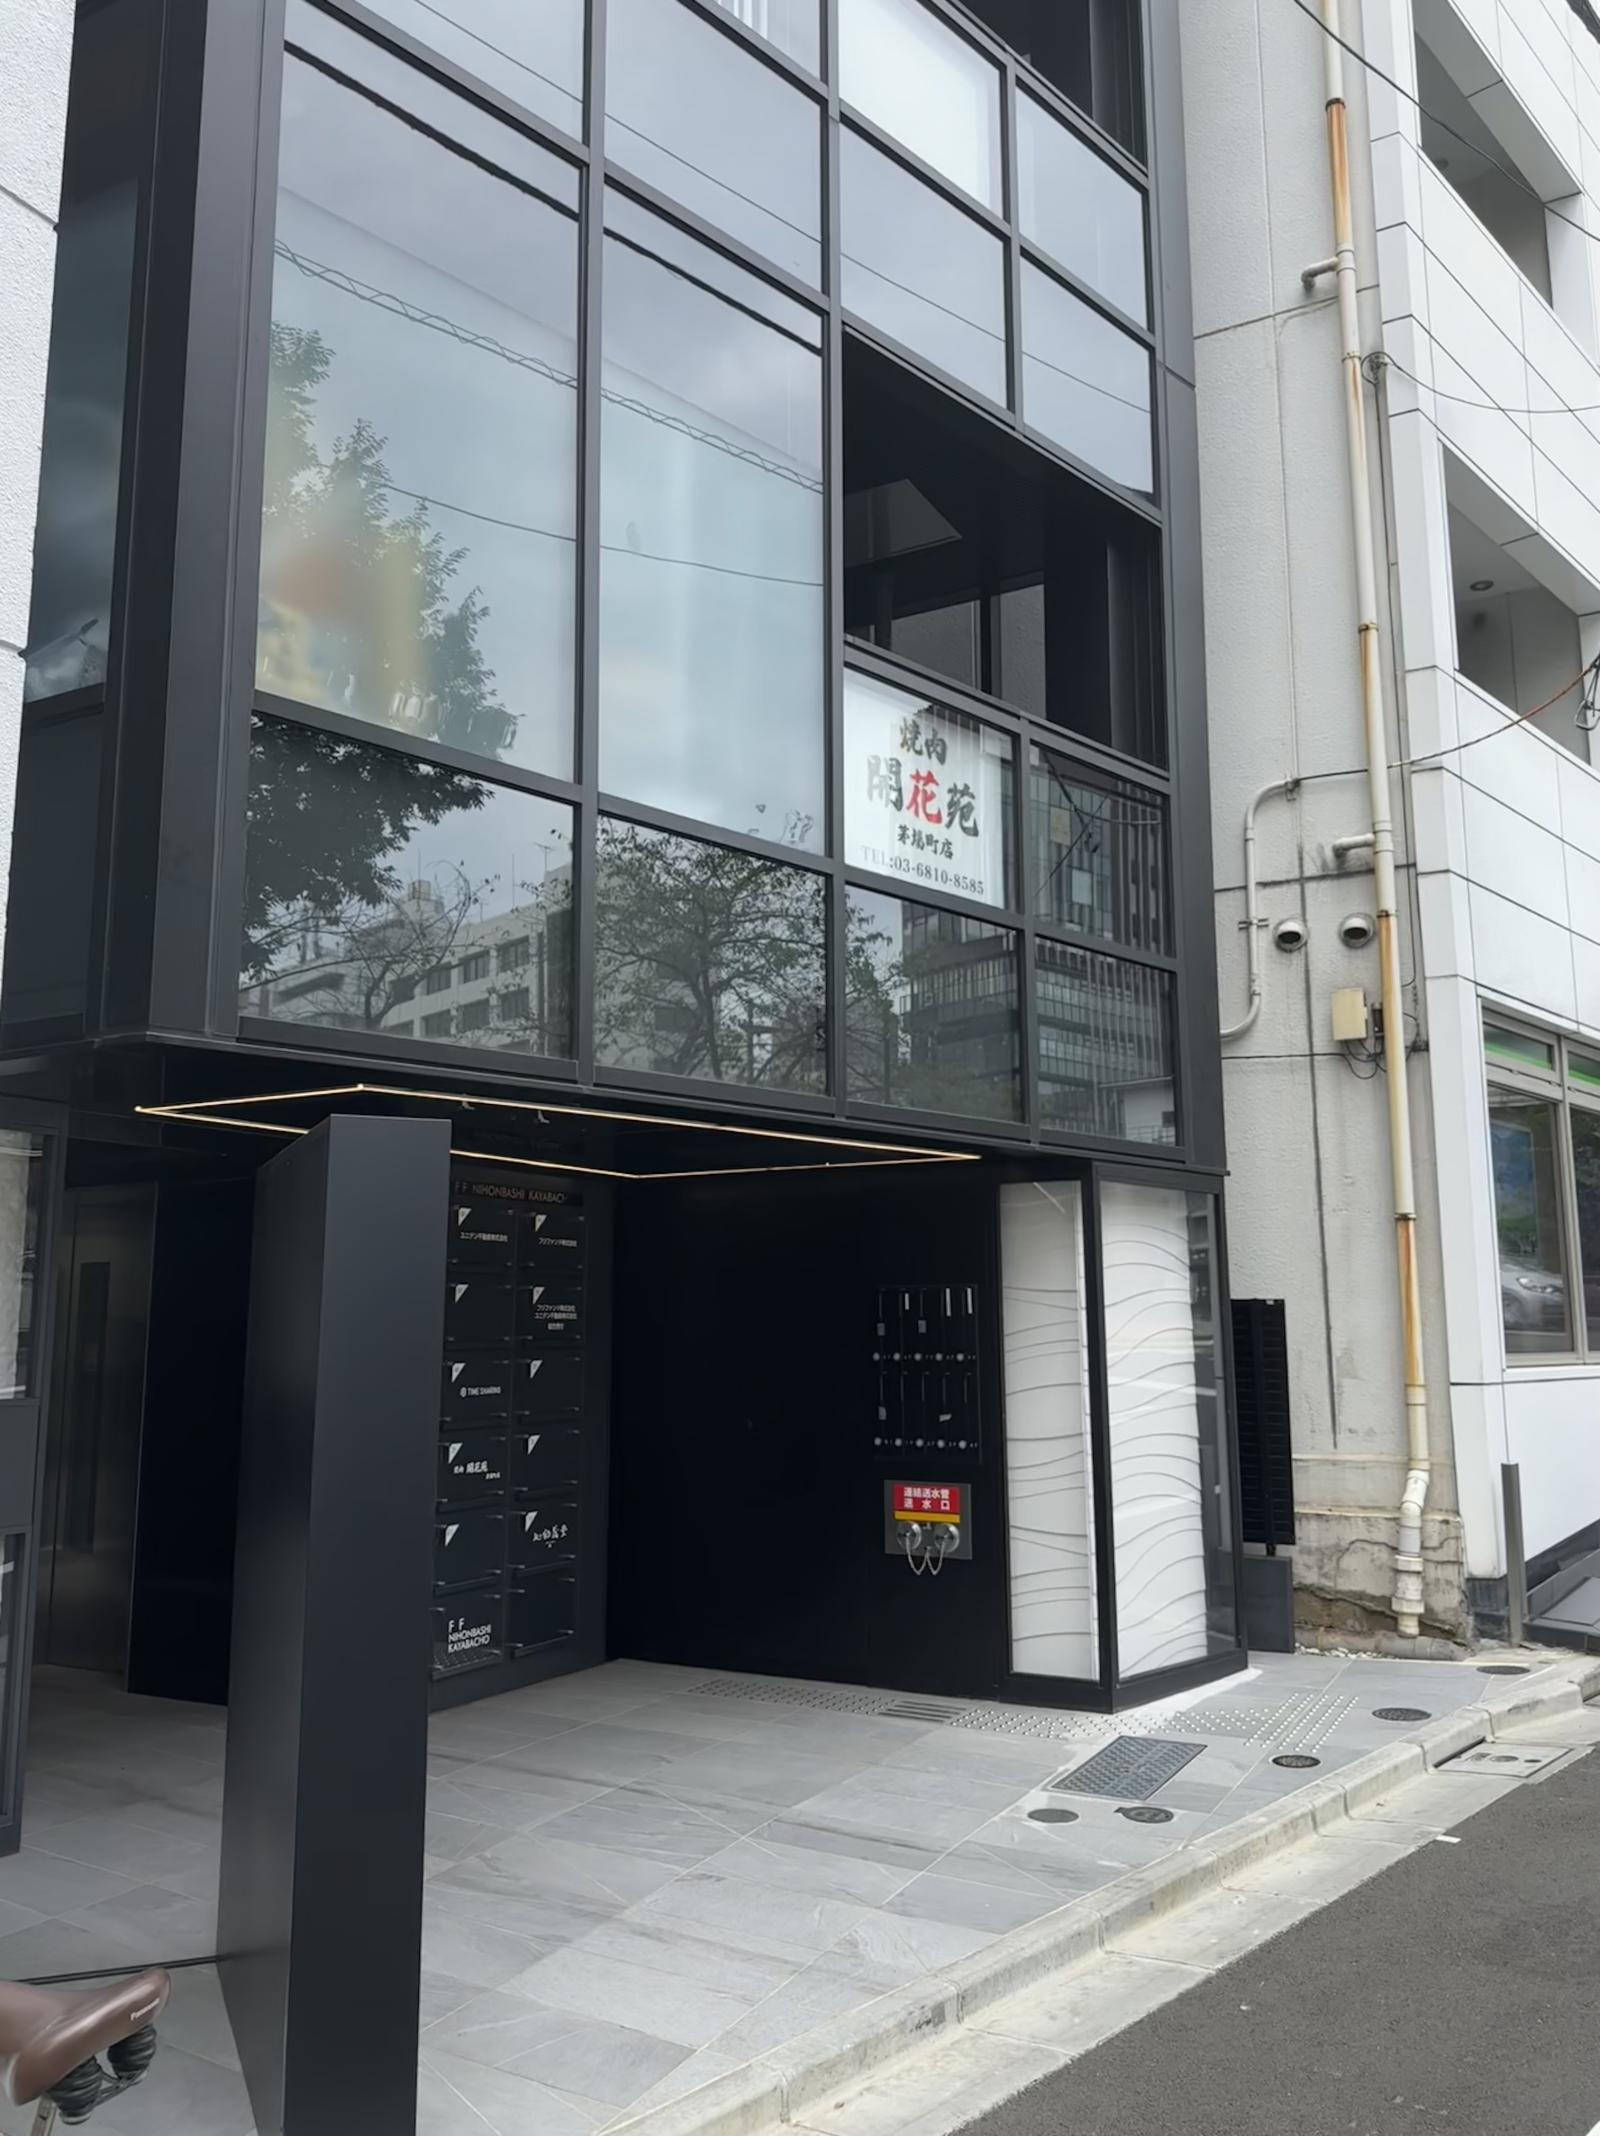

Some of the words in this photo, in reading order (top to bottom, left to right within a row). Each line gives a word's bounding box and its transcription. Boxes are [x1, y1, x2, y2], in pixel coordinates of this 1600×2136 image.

[899, 716, 947, 766] 焼肉
[866, 753, 979, 838] 開花苑
[897, 823, 954, 860] 茅場町店
[448, 1623, 492, 1643] NIHONBASHI
[448, 1634, 490, 1653] KAYABACHO
